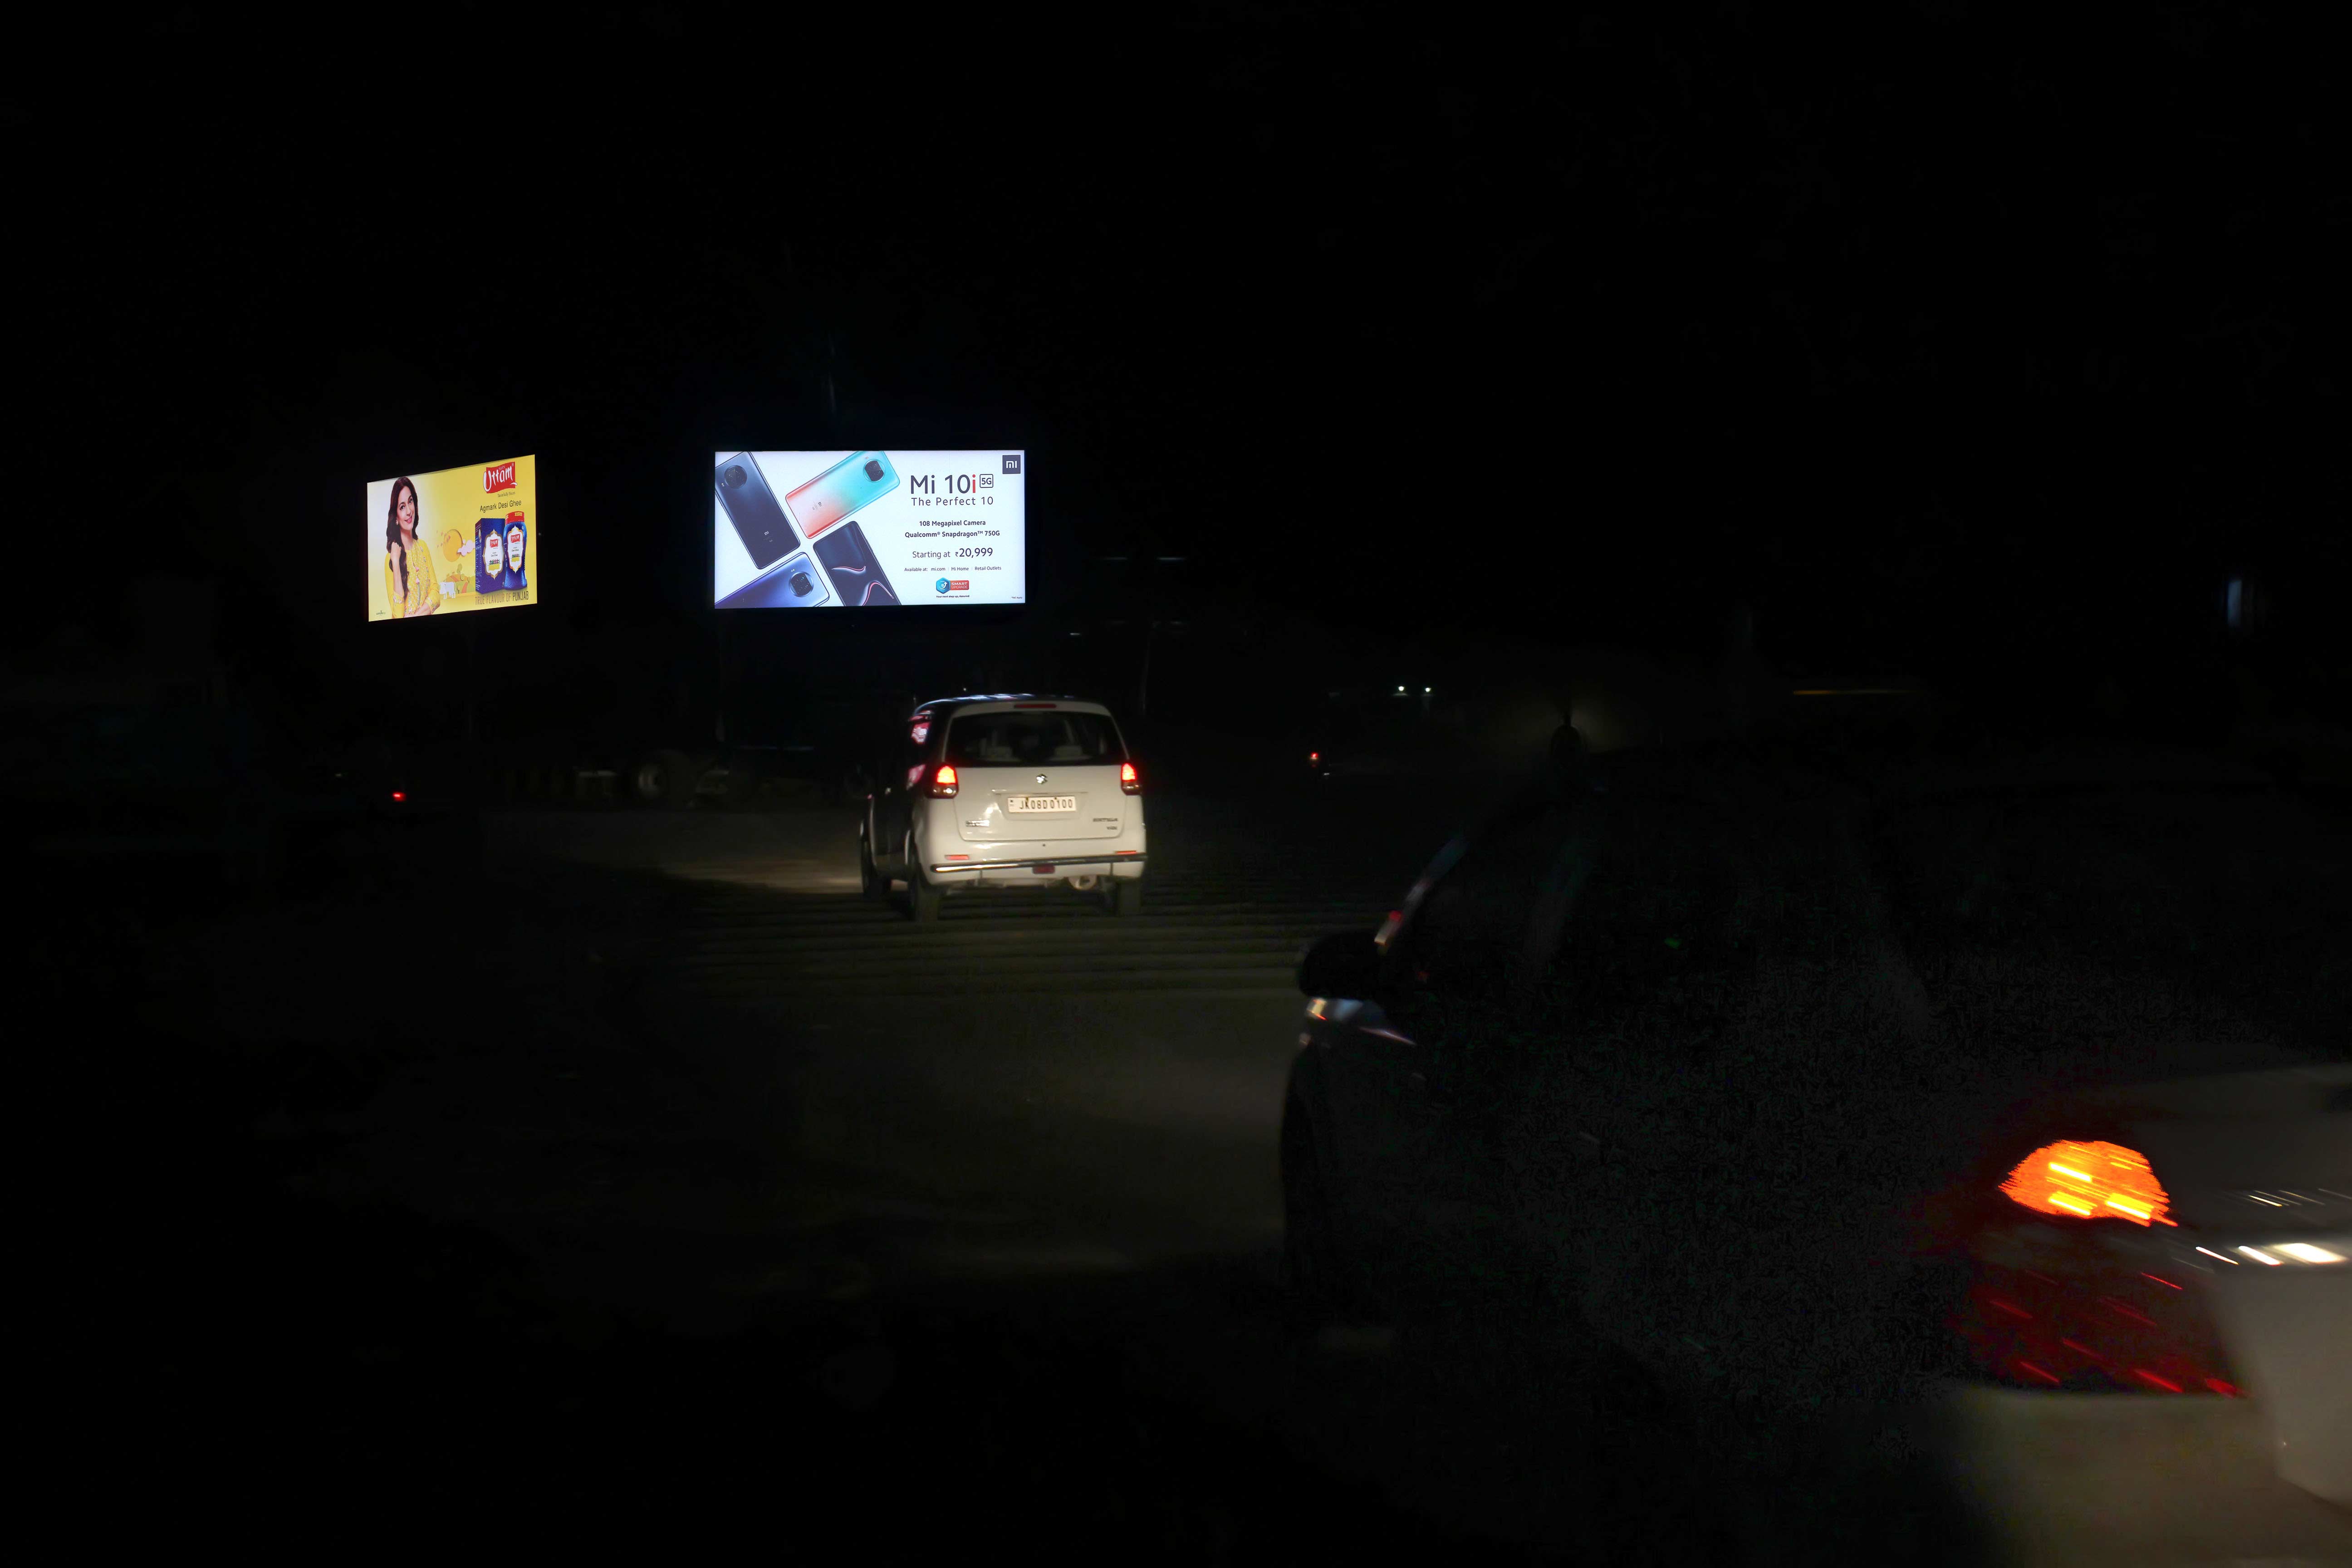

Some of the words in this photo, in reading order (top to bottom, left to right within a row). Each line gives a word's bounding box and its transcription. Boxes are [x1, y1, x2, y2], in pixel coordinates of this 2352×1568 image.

[483, 466, 515, 492] Uttam
[911, 475, 935, 494] Mi
[945, 474, 976, 494] 10i
[911, 497, 931, 506] The
[936, 497, 976, 505] Perfect
[981, 496, 993, 505] 10
[480, 504, 497, 513] Agmark
[912, 551, 941, 559] Starting
[475, 596, 485, 605] TRUE
[486, 593, 505, 604] FLAVOUR
[506, 593, 511, 602] OF
[512, 591, 529, 601] PUNJAB
